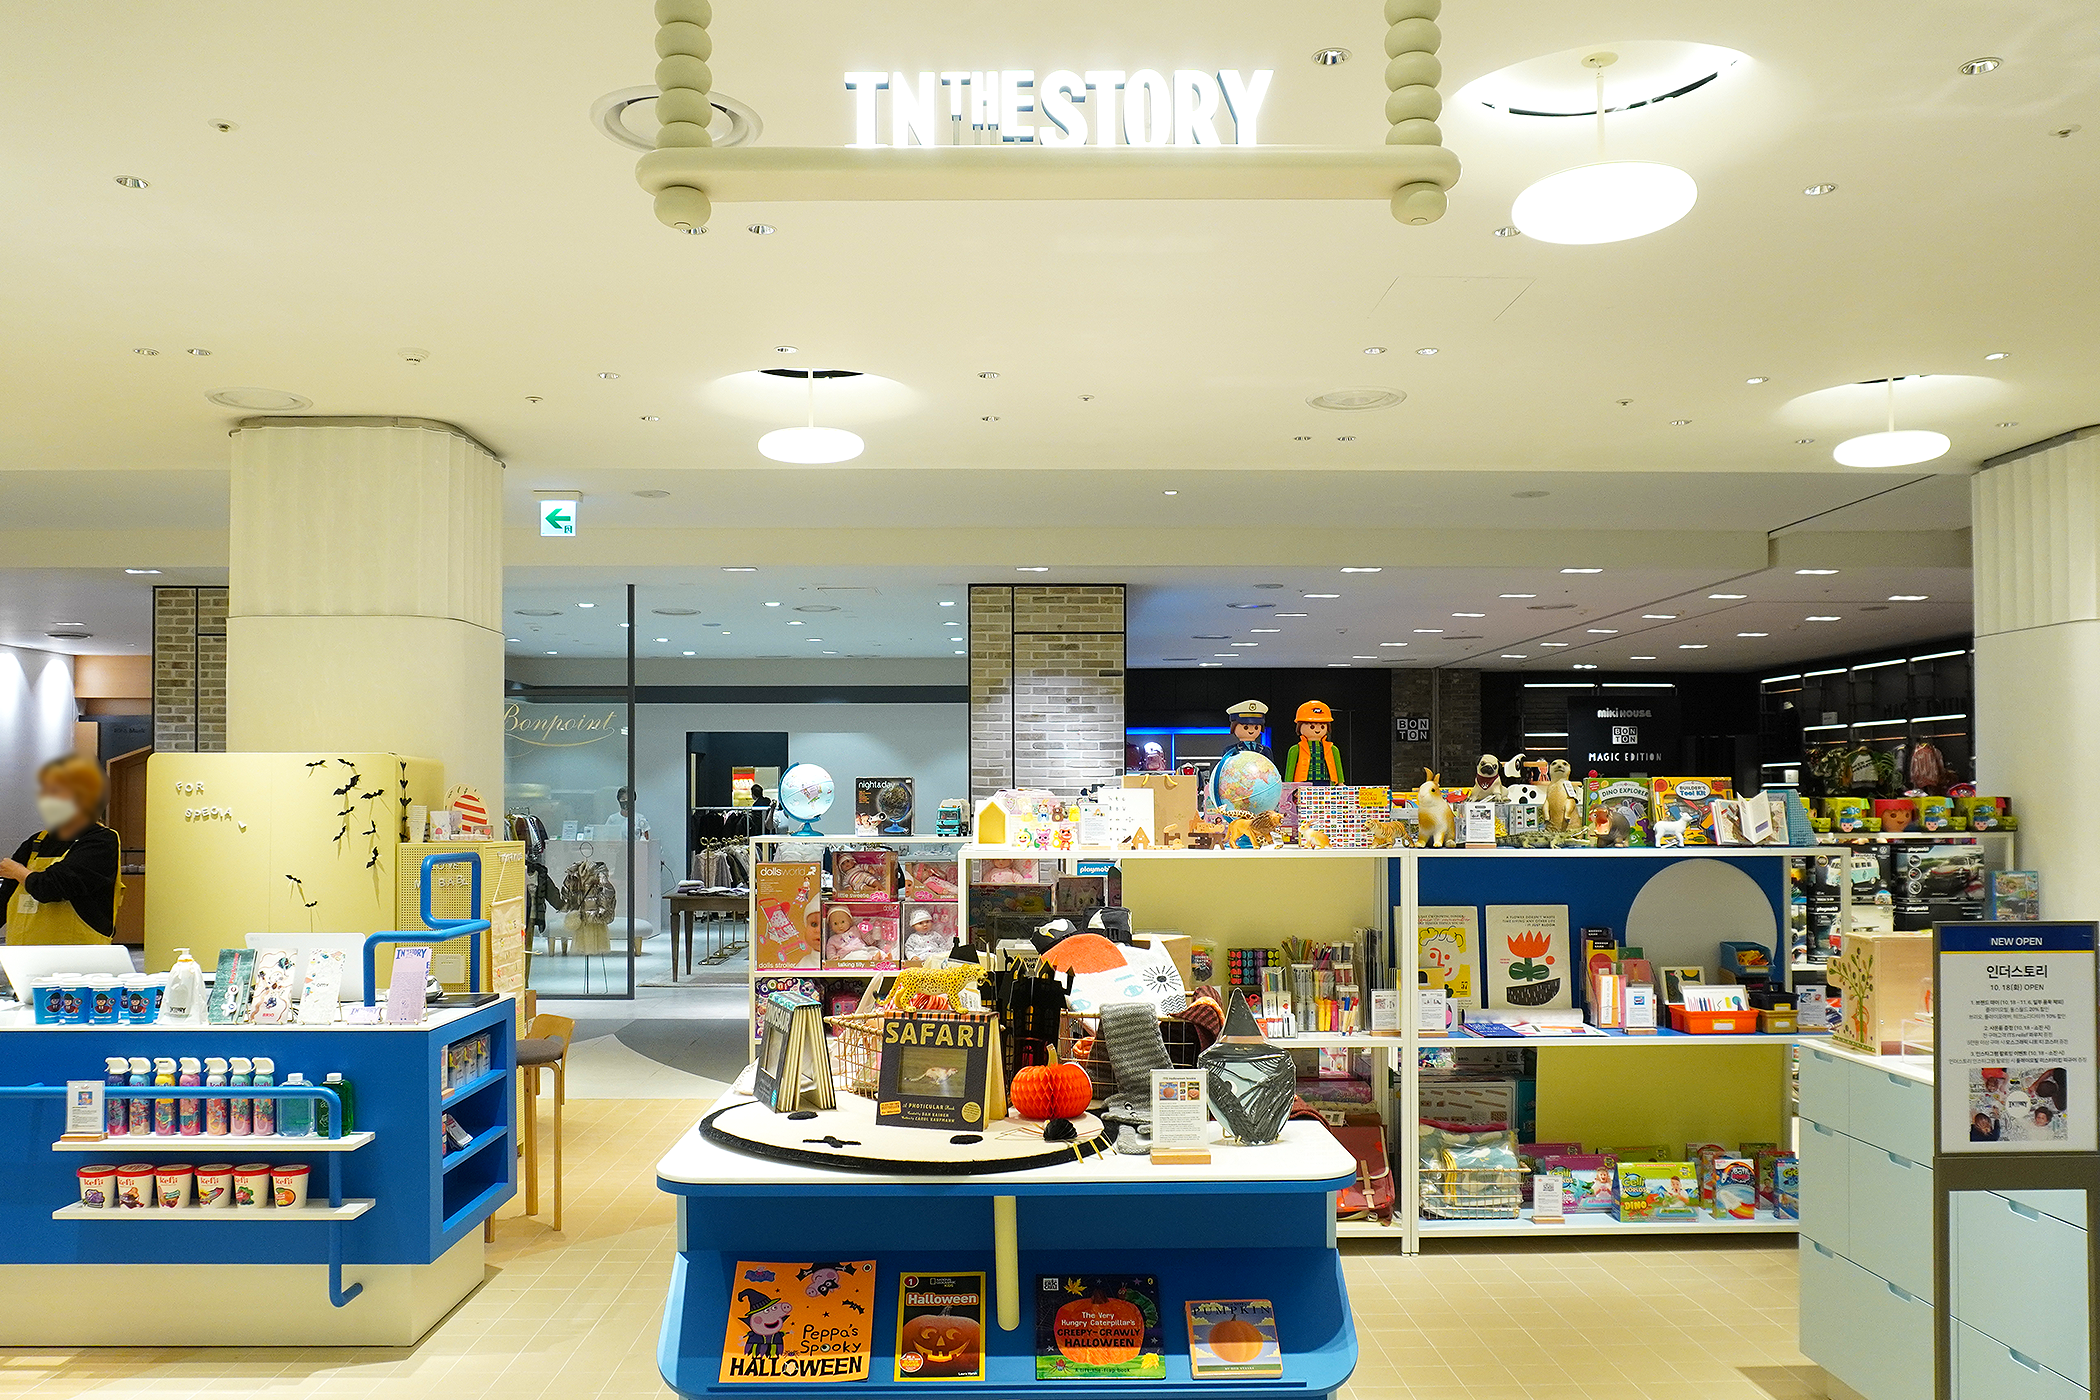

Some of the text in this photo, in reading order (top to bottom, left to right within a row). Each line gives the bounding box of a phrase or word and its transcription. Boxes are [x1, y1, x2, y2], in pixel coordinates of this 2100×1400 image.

[1597, 707, 1619, 718] miki
[503, 703, 618, 741] Bonpoint
[1397, 718, 1429, 729] BON
[1397, 730, 1429, 741] TON
[1588, 752, 1662, 762] MAGIC EDITION
[175, 781, 205, 795] FOR
[1601, 787, 1649, 798] DINO EXPLORER
[1079, 866, 1111, 874] playmob
[1990, 937, 2043, 946] NEW OPEN
[758, 961, 797, 969] dolls stroller
[837, 961, 853, 969] talking
[1986, 965, 2048, 979] 인더스토리
[885, 1021, 985, 1048] SAFARI
[1621, 1176, 1645, 1188] Gelli
[1624, 1200, 1648, 1210] DINO
[908, 1278, 913, 1286] 1
[908, 1294, 977, 1304] Halloween
[1081, 1311, 1115, 1320] The Very
[1192, 1305, 1270, 1316] PUMPKIN
[1061, 1319, 1136, 1328] Hungry Caterpillar's
[802, 1323, 859, 1343] Peppa's
[1056, 1328, 1141, 1337] CREEPY-CRAWLY
[799, 1340, 862, 1356] Spooky
[1064, 1338, 1135, 1348] HALLOWEEN
[729, 1355, 863, 1377] HALLOWEEN
